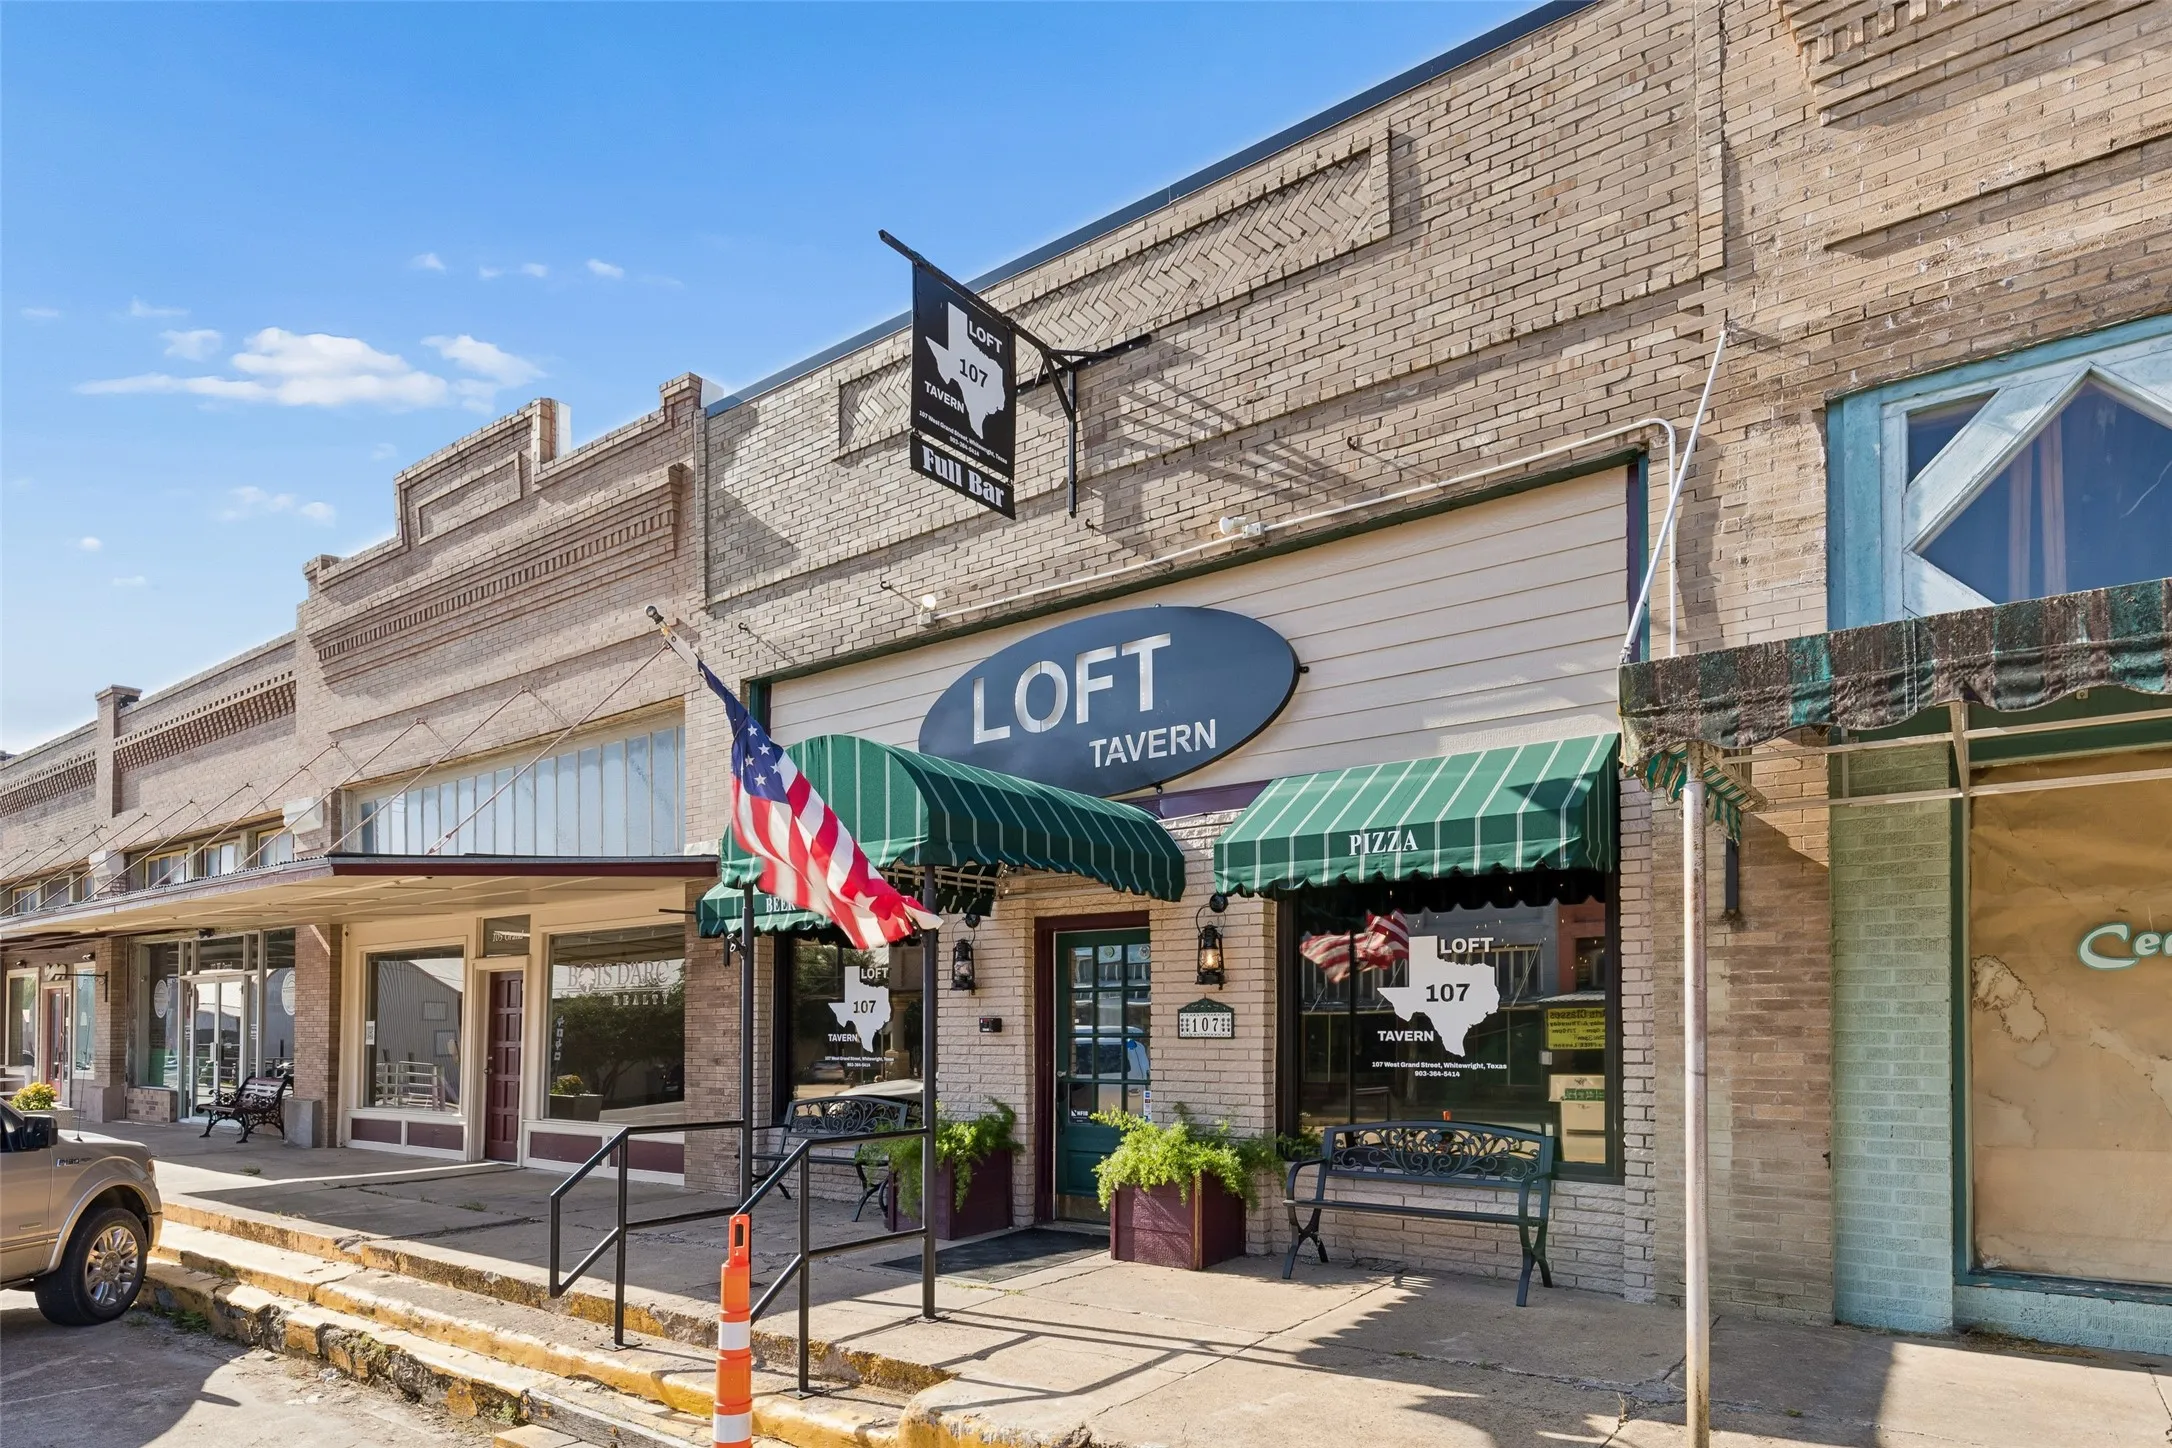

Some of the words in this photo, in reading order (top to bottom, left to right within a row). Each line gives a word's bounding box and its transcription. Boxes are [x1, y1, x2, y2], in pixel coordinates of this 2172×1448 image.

[969, 320, 1003, 353] LOFT
[959, 358, 988, 388] 107
[924, 380, 965, 414] TAVERN
[922, 445, 963, 487] Full
[968, 469, 1005, 508] Bar
[973, 632, 1171, 745] LOFT
[1089, 718, 1216, 768] TAVERN
[1349, 829, 1419, 856] PIZZA
[1440, 937, 1494, 954] LOFT
[567, 962, 612, 994] BOIS
[617, 960, 669, 987] D'ARC
[861, 967, 889, 979] LOFT
[613, 993, 669, 1006] REALTY
[1426, 983, 1471, 1002] 107
[853, 1000, 876, 1014] 107
[1192, 1017, 1219, 1033] 107
[828, 1033, 858, 1042] TAVERN
[1377, 1030, 1434, 1042] TAVERN
[1421, 1061, 1443, 1069] Street,
[1443, 1062, 1486, 1070] Whitewright,
